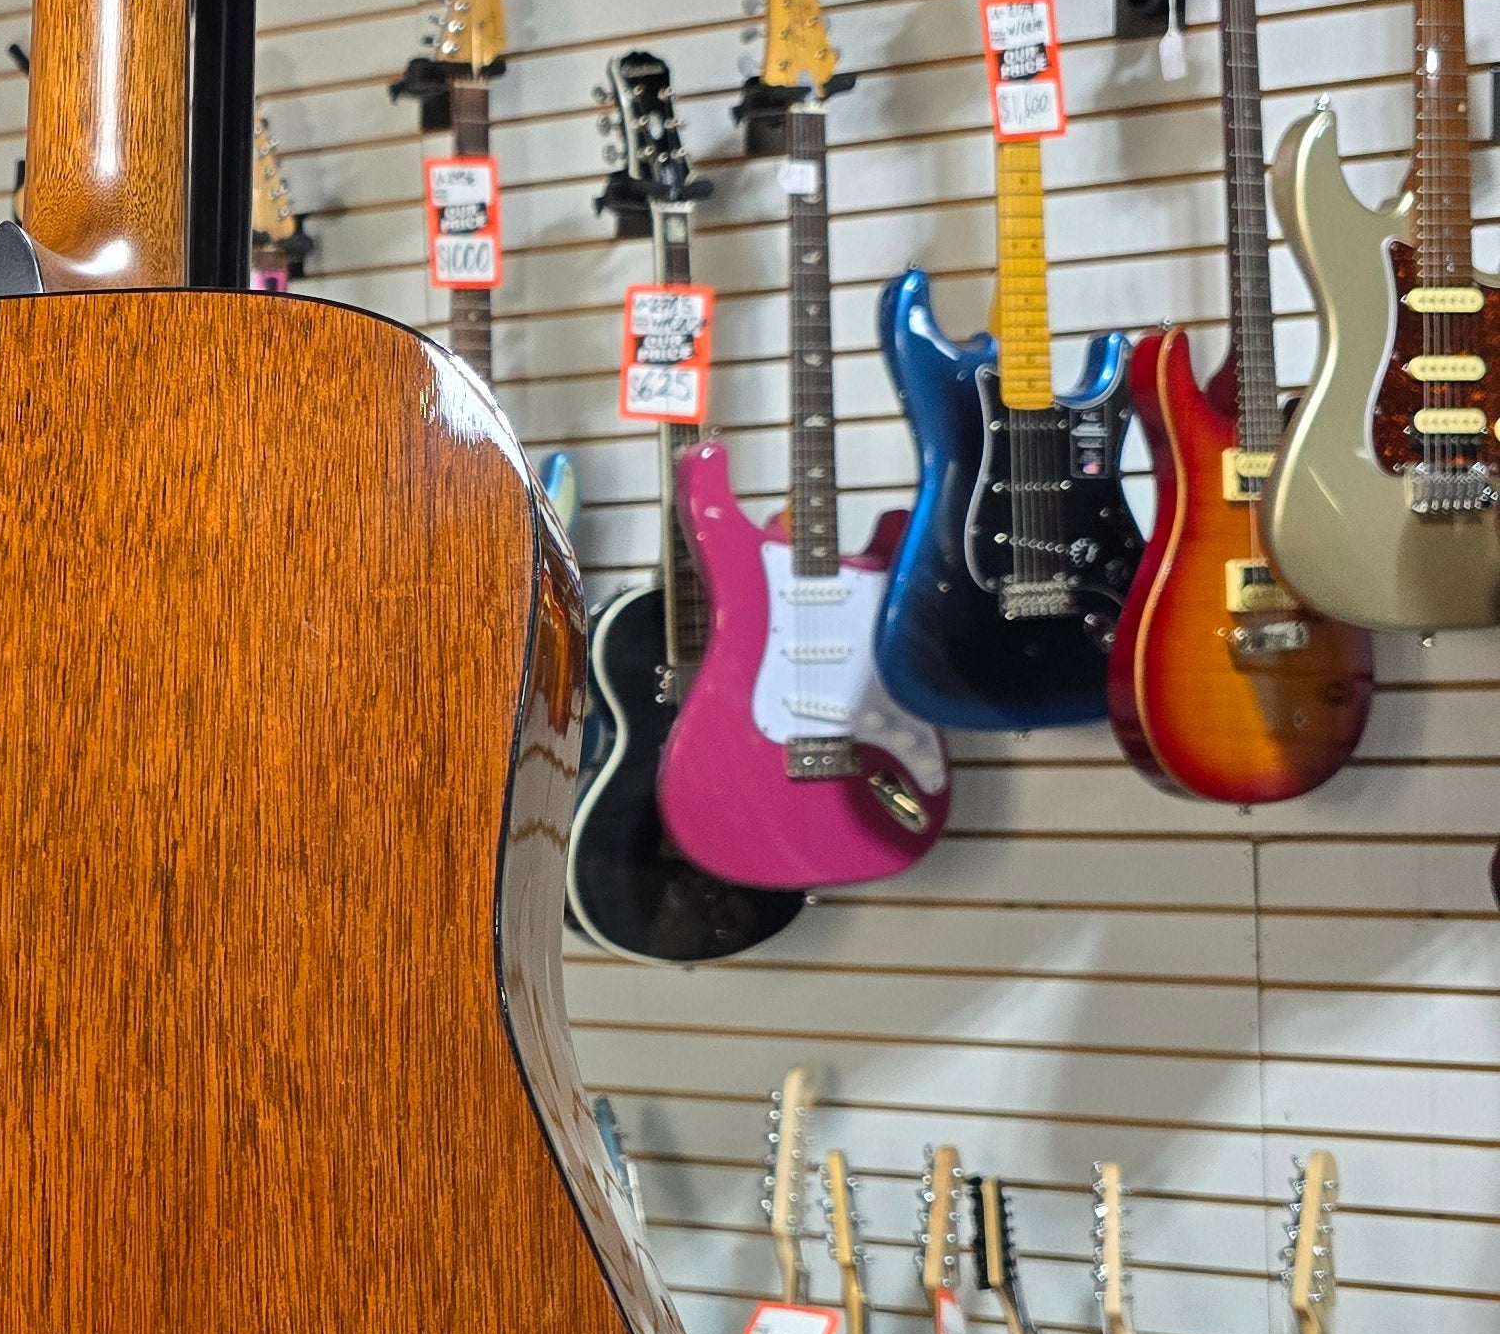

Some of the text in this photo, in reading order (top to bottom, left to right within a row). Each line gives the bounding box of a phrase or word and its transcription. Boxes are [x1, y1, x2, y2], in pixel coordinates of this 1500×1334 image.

[1004, 46, 1039, 64] OUR
[1000, 56, 1048, 80] PRICE
[444, 205, 479, 221] OUR
[441, 214, 488, 234] PRICE
[643, 335, 687, 348] OUR
[637, 346, 694, 363] PRICE
[630, 370, 691, 403] $625
